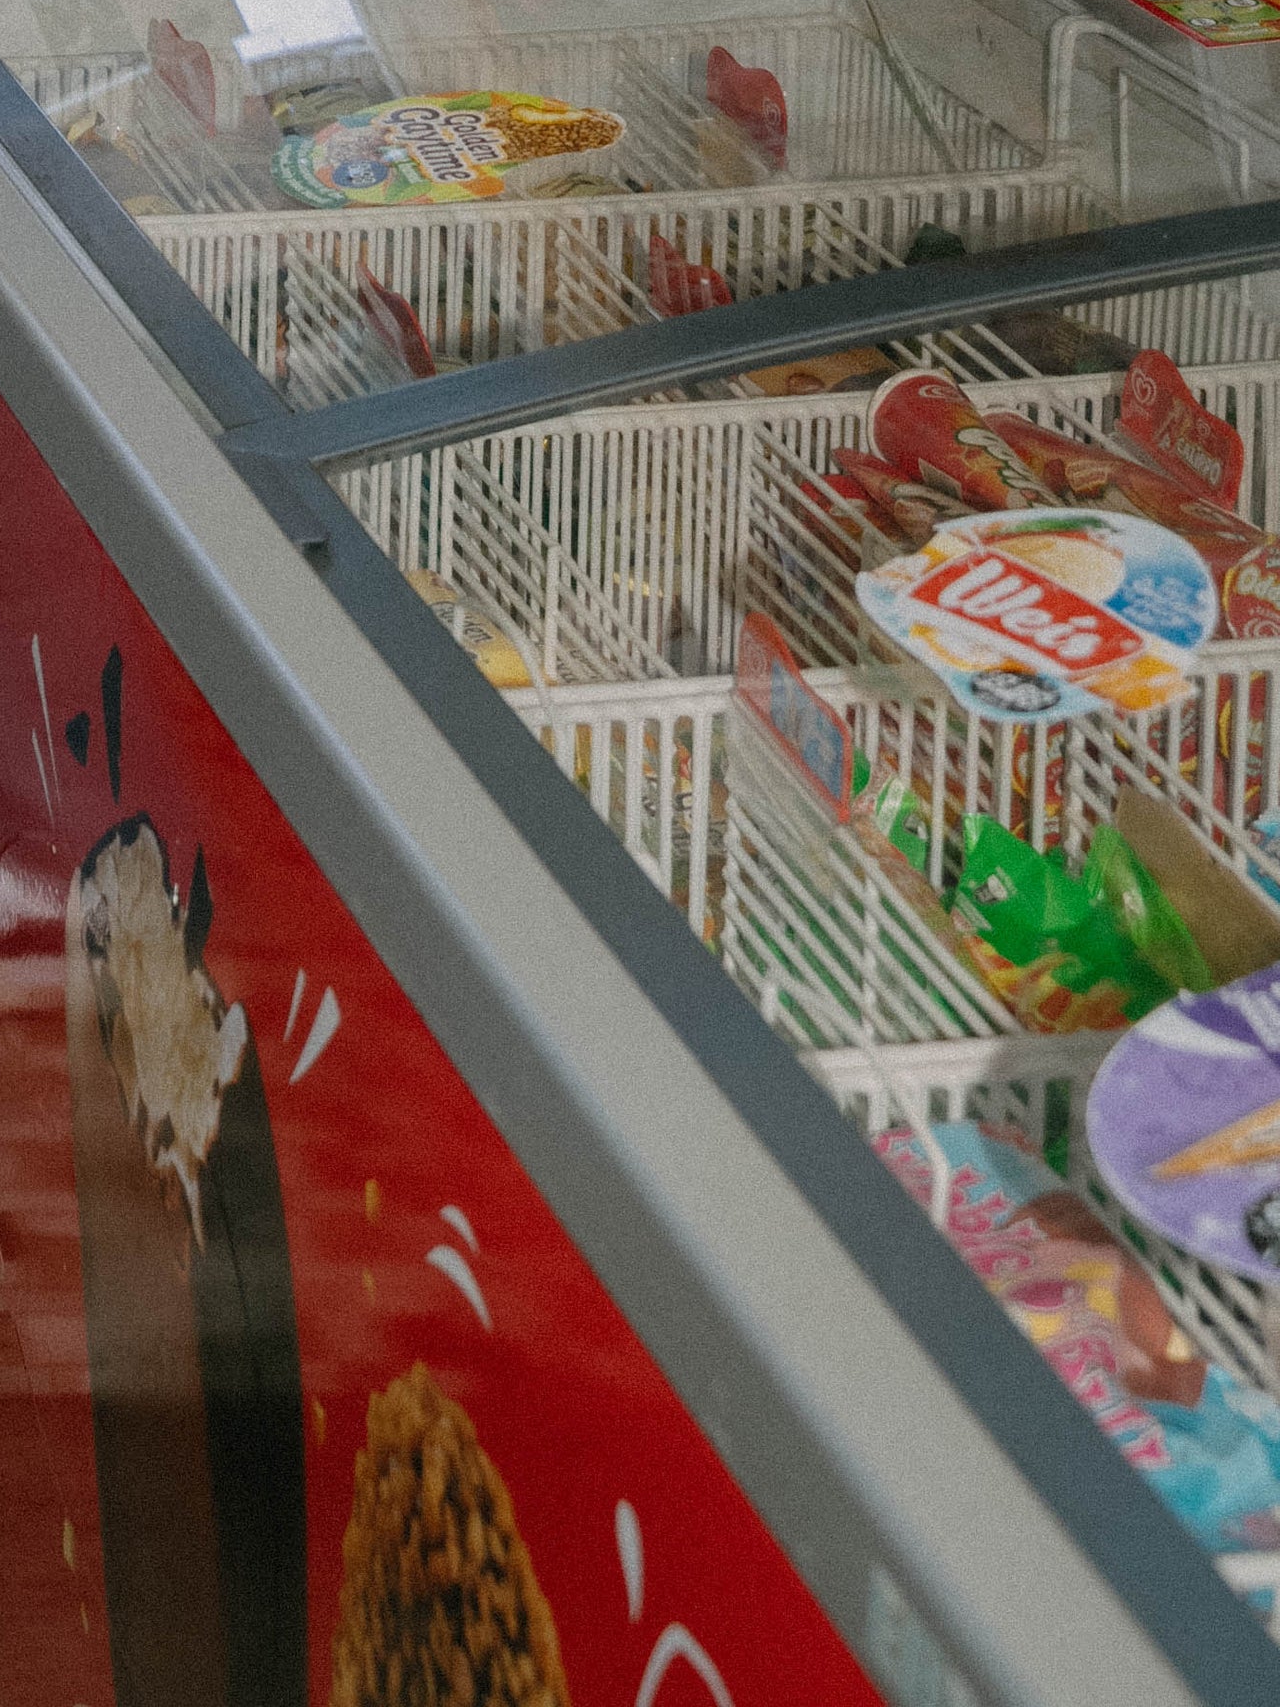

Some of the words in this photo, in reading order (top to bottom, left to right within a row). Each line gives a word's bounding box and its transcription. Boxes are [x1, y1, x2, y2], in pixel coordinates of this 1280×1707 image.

[388, 104, 475, 184] Gaytime
[443, 110, 500, 164] Golden
[938, 559, 1102, 661] Weis
